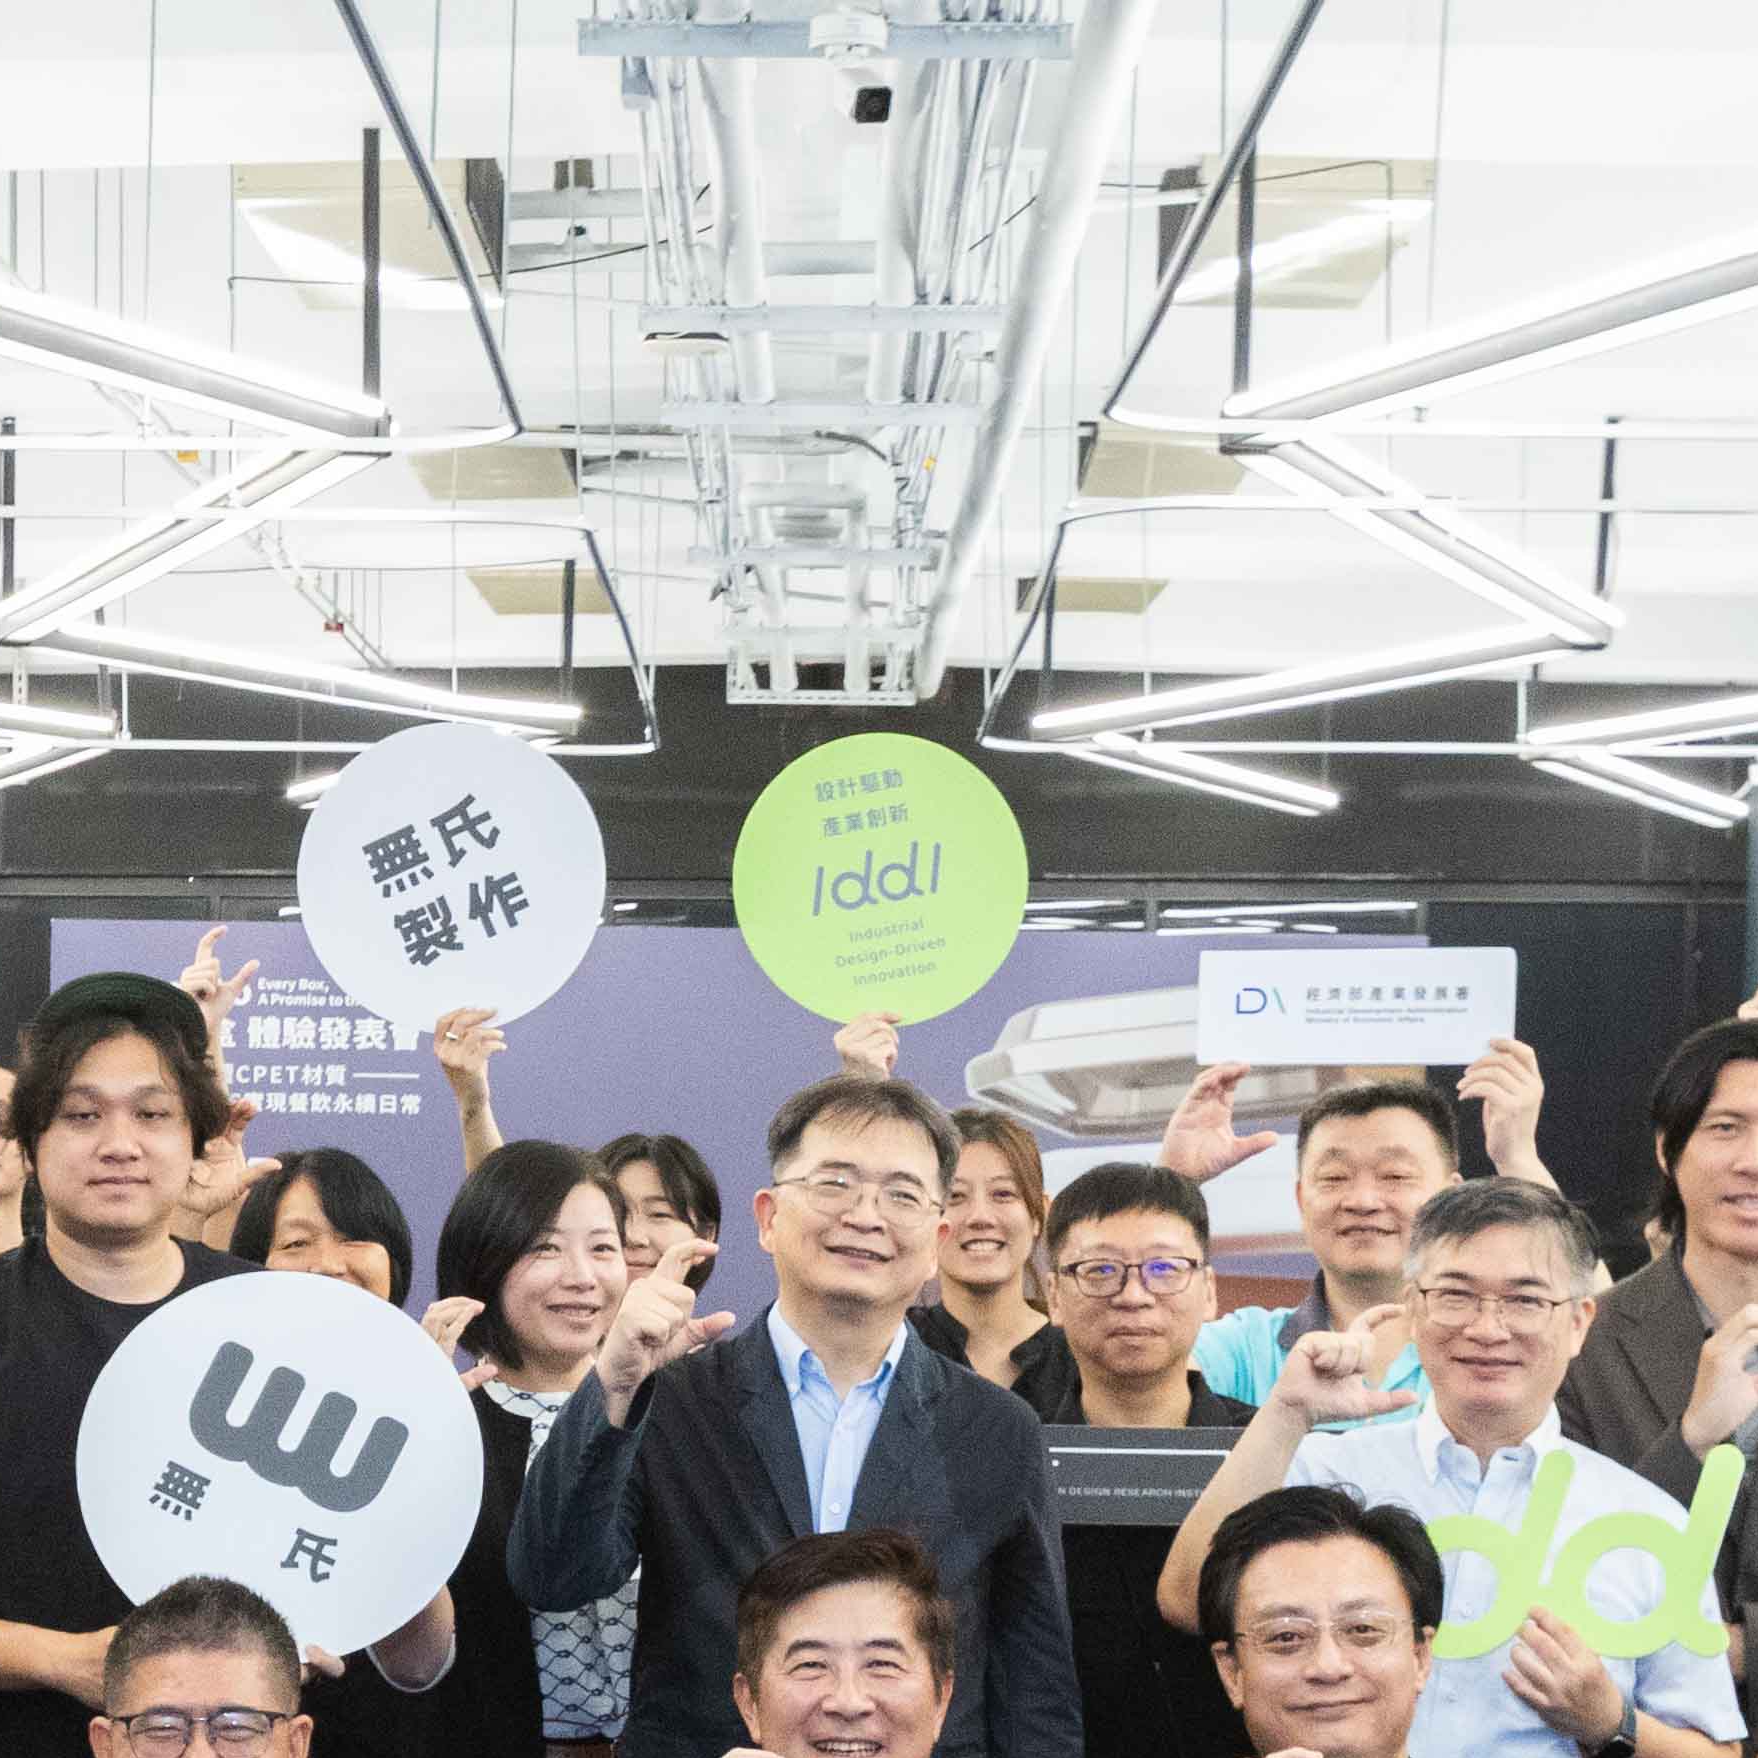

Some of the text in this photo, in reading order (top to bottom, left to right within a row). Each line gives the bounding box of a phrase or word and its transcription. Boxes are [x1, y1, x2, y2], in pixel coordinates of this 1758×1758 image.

[815, 768, 904, 802] 設計驅動
[822, 803, 909, 838] 產業創新
[362, 794, 500, 898] 無氏
[394, 872, 530, 966] 製作
[849, 917, 925, 943] Industrial
[257, 977, 297, 993] Every
[852, 960, 938, 986] Innovation
[1068, 1486, 1111, 1497] DESIGN
